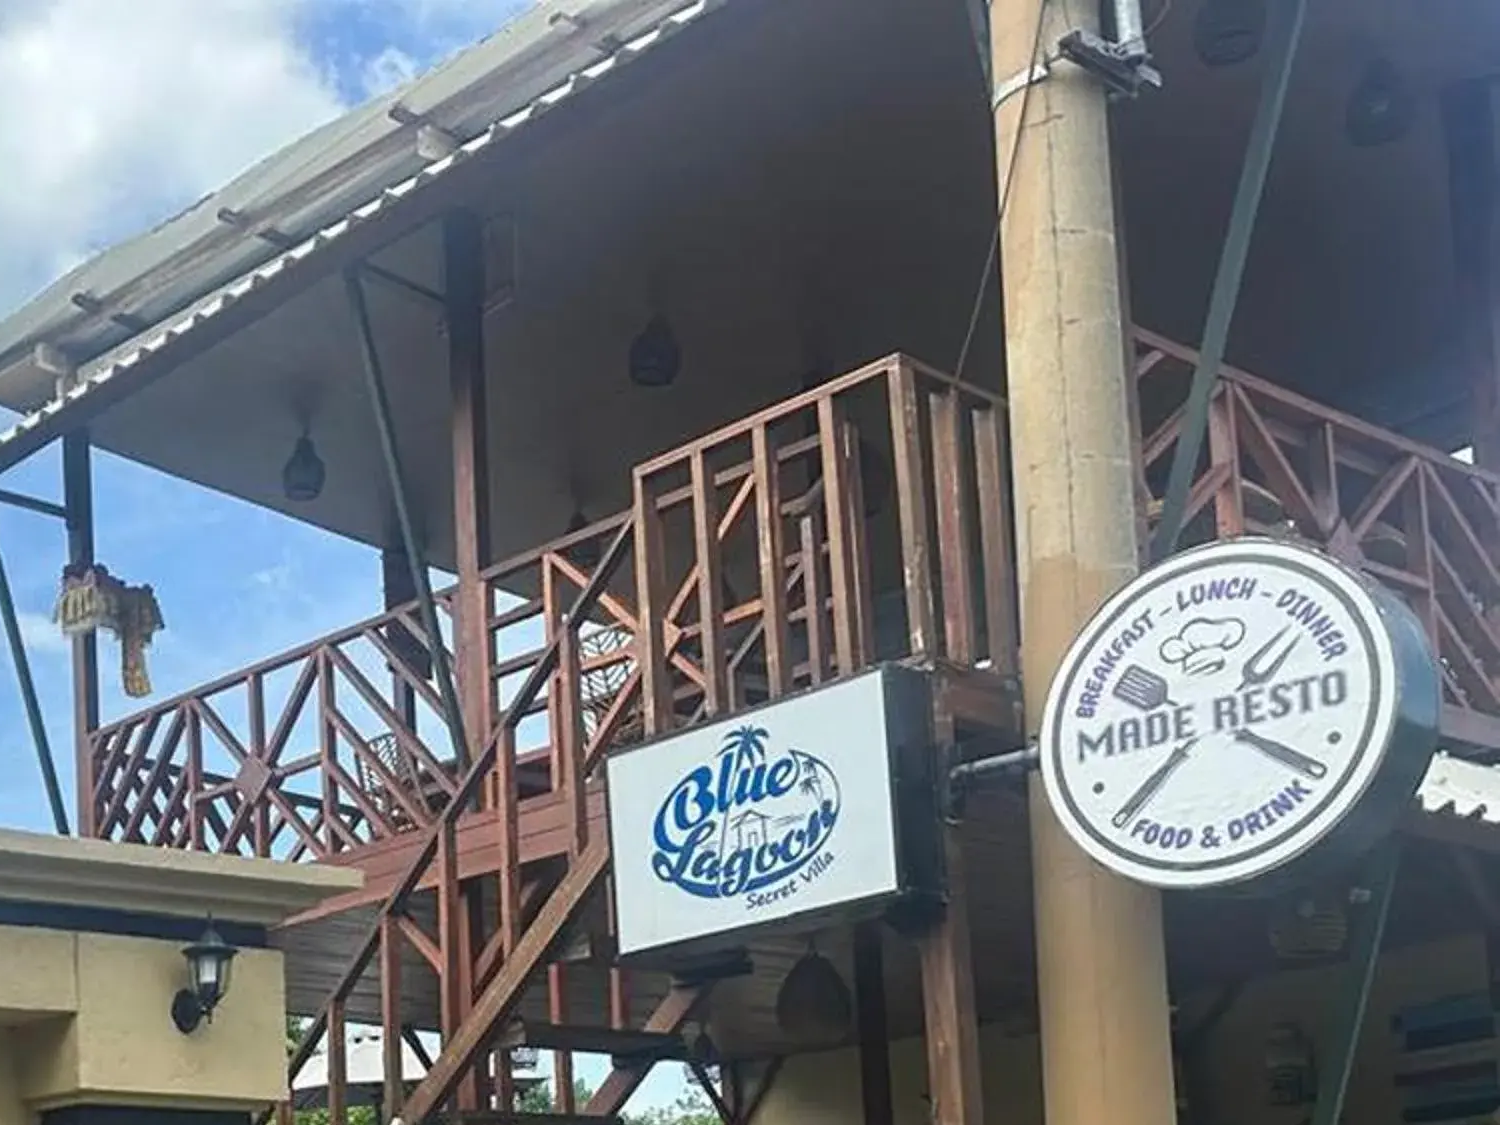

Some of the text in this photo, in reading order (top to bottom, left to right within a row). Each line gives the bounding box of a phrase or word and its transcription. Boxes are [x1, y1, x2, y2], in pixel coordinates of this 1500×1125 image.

[1076, 610, 1154, 719] BREAKFAST
[1176, 577, 1256, 611] LUNCH
[1276, 589, 1348, 661] DINNER
[1077, 670, 1348, 763] MADE RESTO
[656, 748, 799, 842] Blue
[1130, 781, 1313, 850] FOOD & DRINK
[652, 798, 837, 897] Lagoon
[746, 851, 835, 910] Secret Villa
